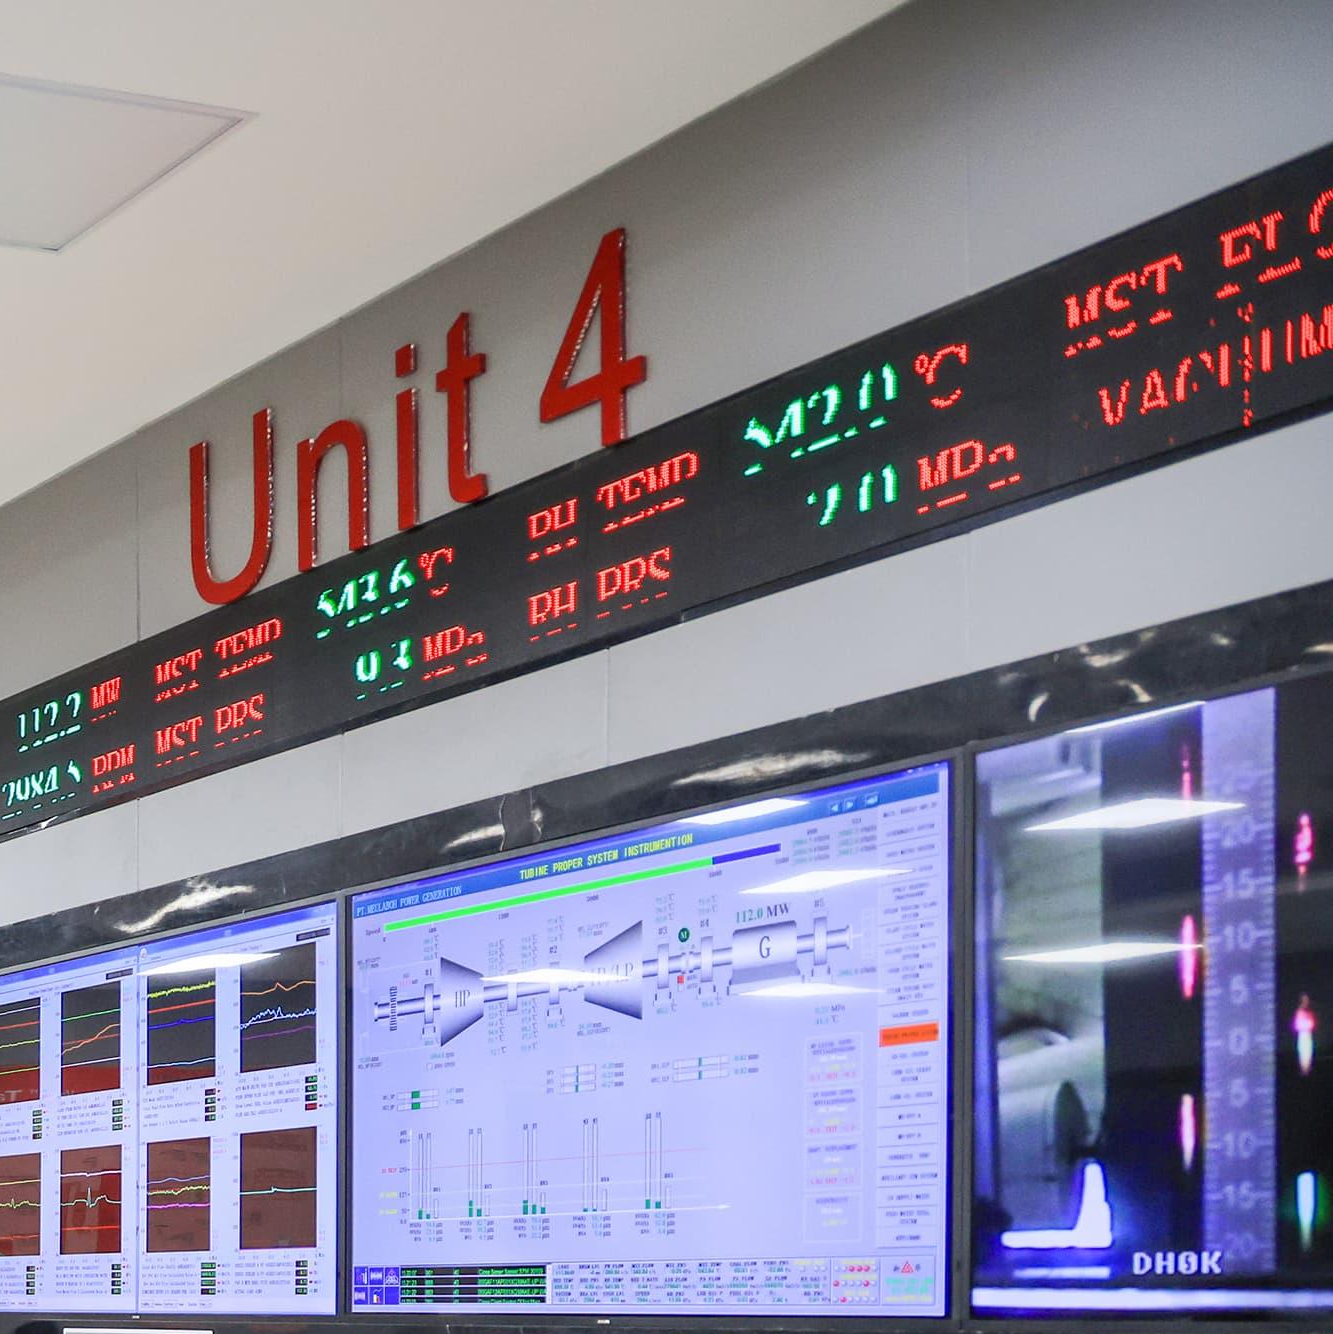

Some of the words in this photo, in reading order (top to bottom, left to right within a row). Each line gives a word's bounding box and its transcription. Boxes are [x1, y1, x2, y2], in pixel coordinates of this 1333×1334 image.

[189, 312, 488, 606] Unit
[540, 227, 647, 447] 4
[154, 646, 202, 702] MST
[1064, 252, 1183, 358] MST
[154, 715, 204, 767] MST
[520, 865, 548, 881] TUBINE
[553, 857, 583, 873] PROPER
[587, 849, 618, 866] SYSTEM
[766, 902, 790, 918] MW
[759, 936, 771, 959] G
